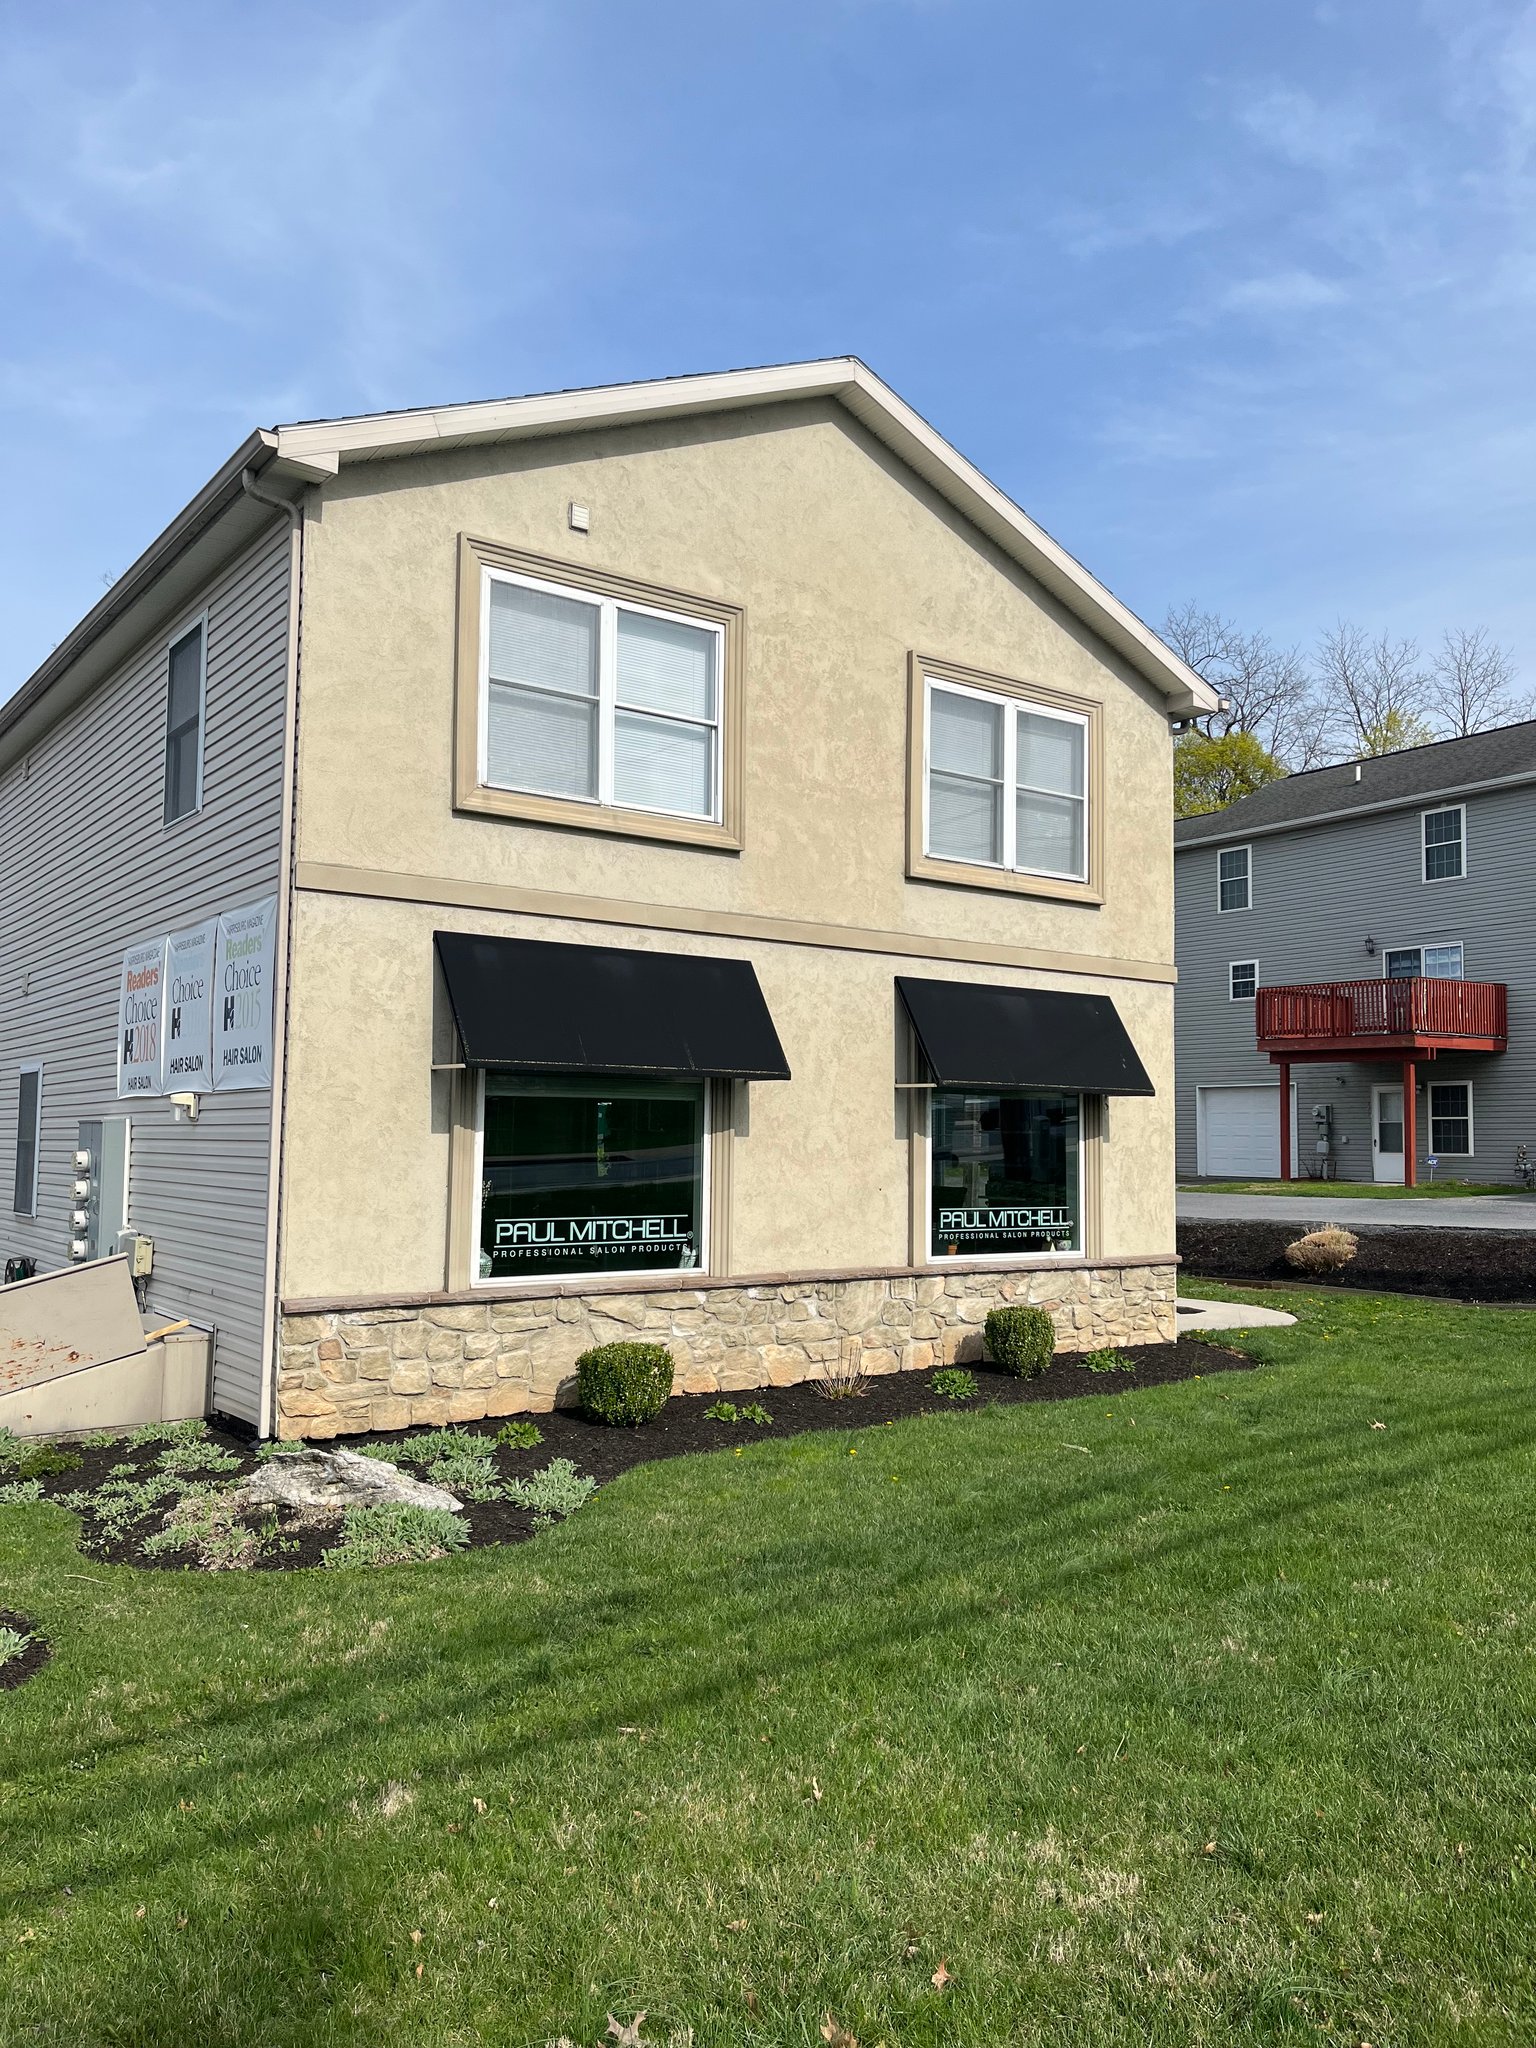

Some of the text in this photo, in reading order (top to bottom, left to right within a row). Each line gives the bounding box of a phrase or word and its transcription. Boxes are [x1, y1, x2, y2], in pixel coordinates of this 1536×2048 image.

[224, 960, 262, 993] Choice
[172, 974, 204, 1005] Choice
[125, 991, 158, 1025] Choice
[132, 1022, 157, 1063] 2018
[170, 1055, 204, 1074] HAIR SALON
[223, 1045, 263, 1067] HAIR SALON
[127, 1075, 152, 1090] HAIR SALON
[941, 1211, 986, 1229] PAUL
[496, 1221, 566, 1244] PAUL
[938, 1229, 1070, 1240] PROFESSIONAL SALON PRODUCTS
[492, 1243, 688, 1259] PROFESSIONAL SALON PRODUCTS
